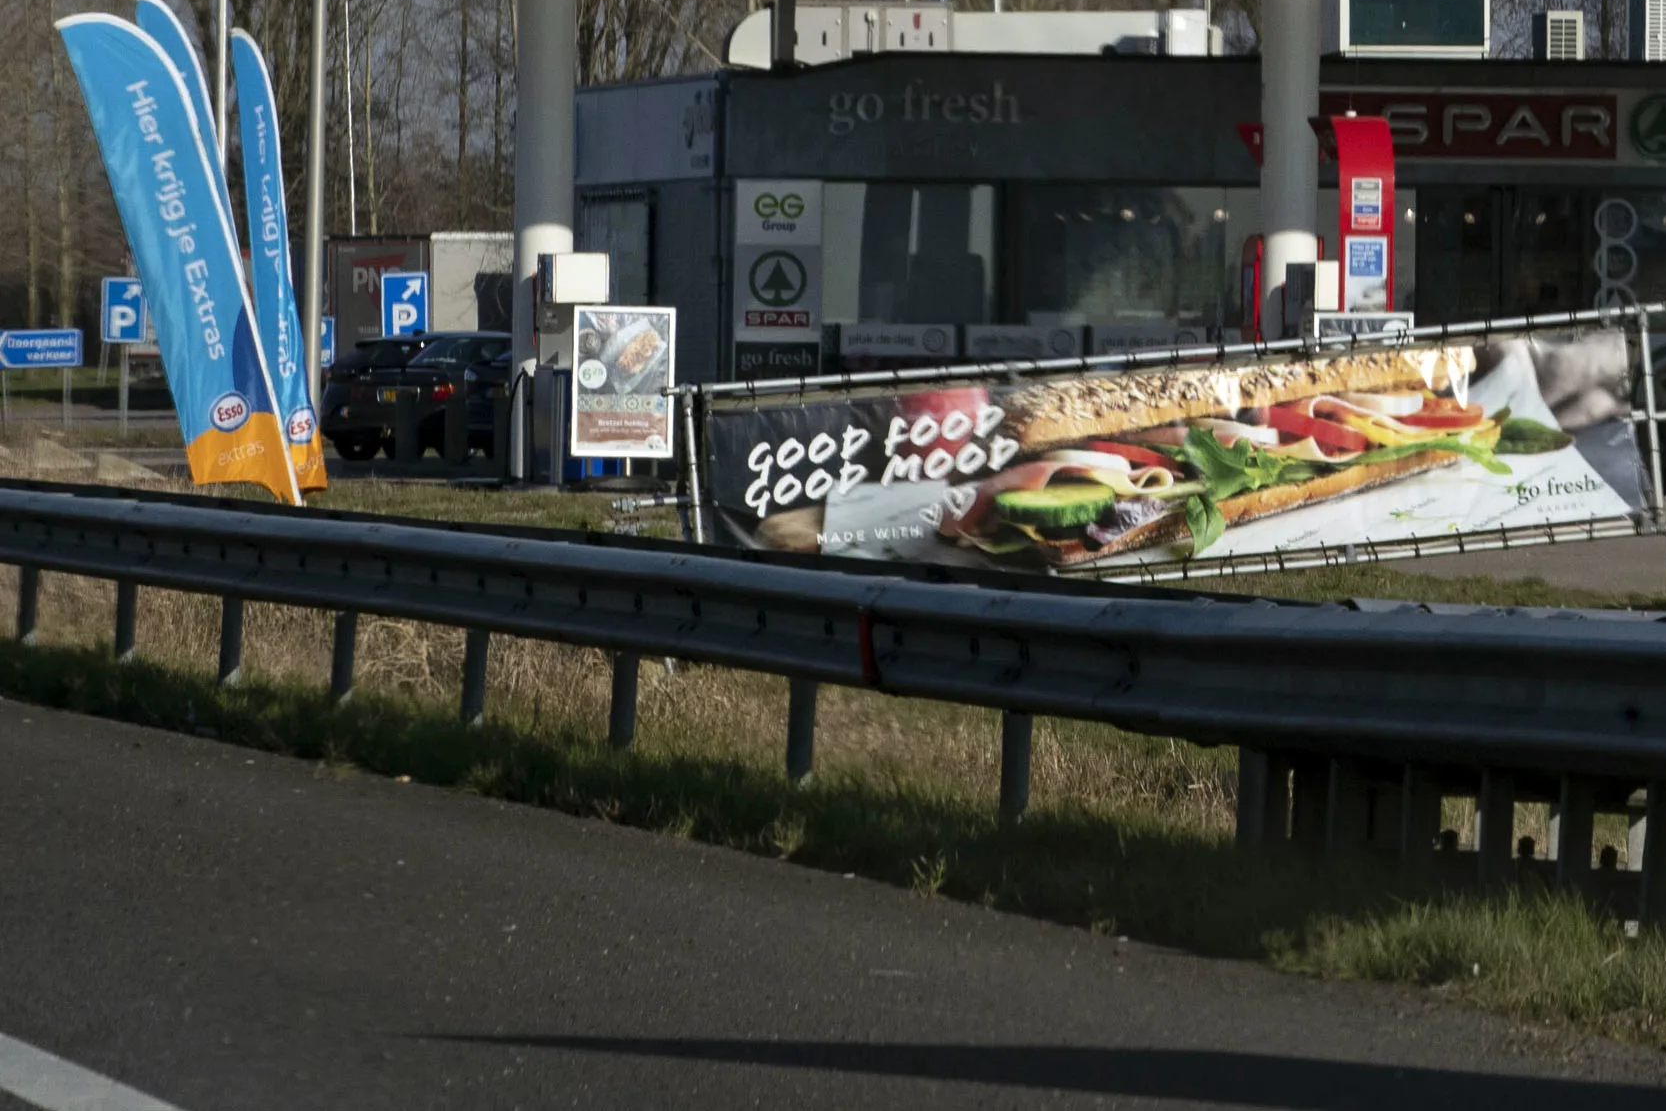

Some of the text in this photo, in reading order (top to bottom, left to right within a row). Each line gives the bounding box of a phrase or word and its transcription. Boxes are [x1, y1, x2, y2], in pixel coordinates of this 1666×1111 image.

[828, 77, 1022, 136] go fresh
[1381, 103, 1611, 149] SPAR
[126, 79, 225, 361] Hier krijg je Extras
[762, 220, 797, 234] Group
[109, 304, 137, 338] P
[392, 302, 418, 336] P
[746, 312, 809, 326] SPAR
[740, 346, 813, 370] go fresh
[217, 440, 265, 467] extras
[748, 402, 1006, 486] GOOD FOOD
[744, 434, 1020, 519] GOOD MOOD
[1516, 473, 1597, 506] go fresh
[816, 525, 926, 545] MADE WITH
